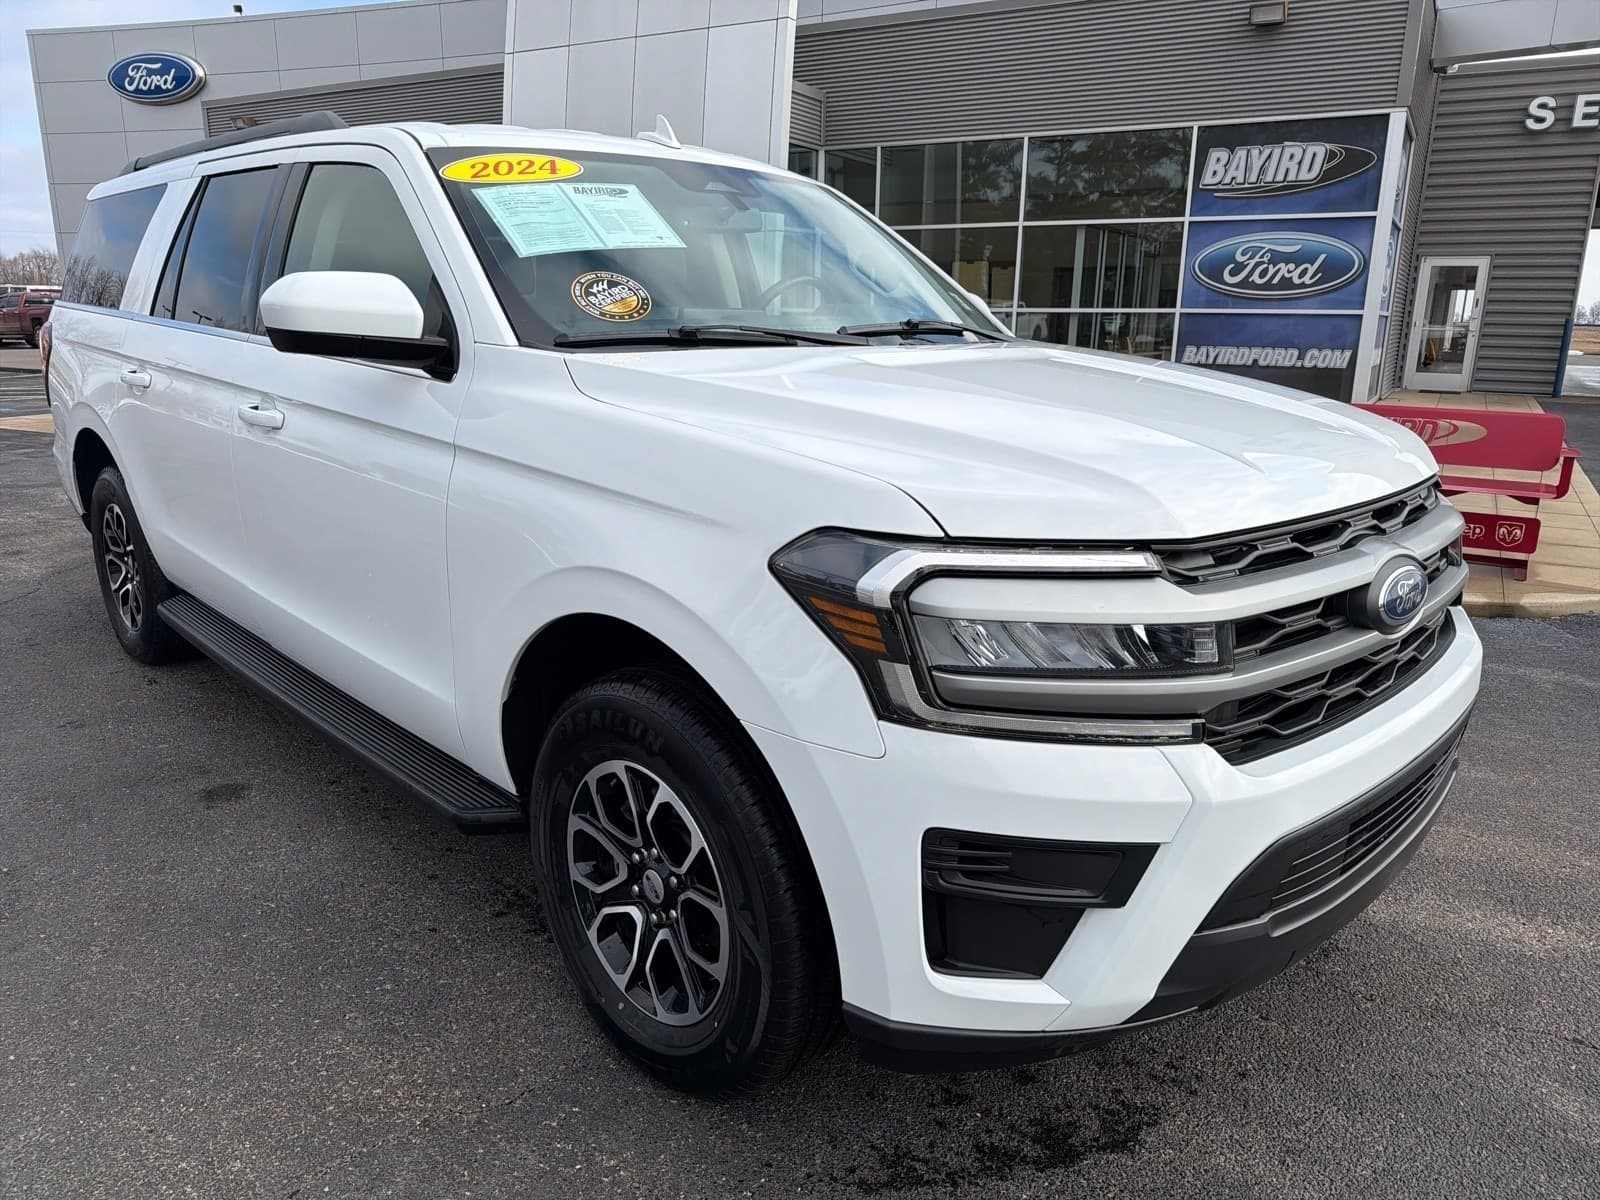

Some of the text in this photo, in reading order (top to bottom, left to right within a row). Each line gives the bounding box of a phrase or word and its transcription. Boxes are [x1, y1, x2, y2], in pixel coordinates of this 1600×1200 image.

[124, 62, 176, 91] Ford
[1525, 94, 1600, 130] SE
[470, 160, 560, 179] 2024
[1201, 142, 1328, 187] BAYIRD
[1223, 243, 1327, 285] Ford
[587, 285, 629, 304] BAYIRD
[596, 290, 635, 308] CERTIFIED
[1181, 345, 1353, 369] BAYIRDFORD.COM
